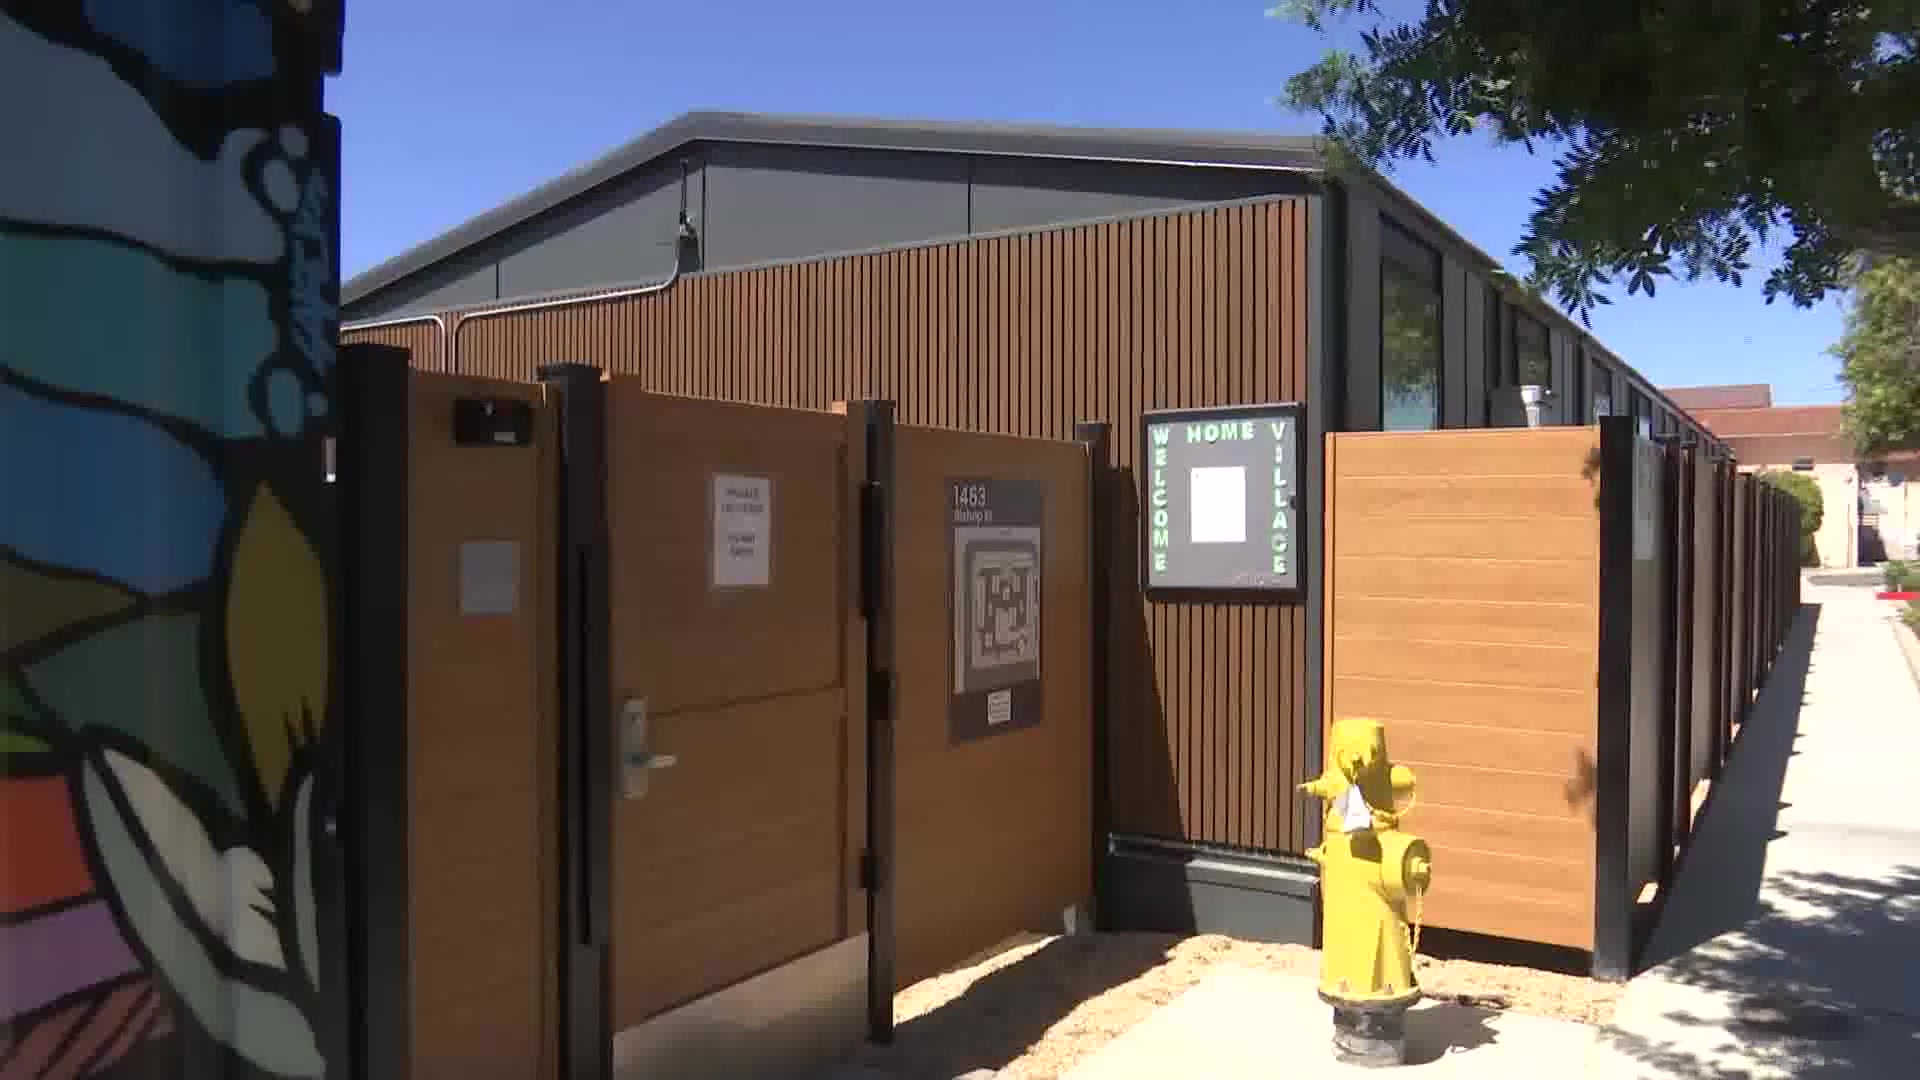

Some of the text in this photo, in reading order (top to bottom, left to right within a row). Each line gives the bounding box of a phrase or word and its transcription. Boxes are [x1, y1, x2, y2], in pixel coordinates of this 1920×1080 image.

[1152, 428, 1169, 572] WELCOME
[1187, 422, 1254, 443] HOME
[1271, 422, 1289, 574] VILLAGE
